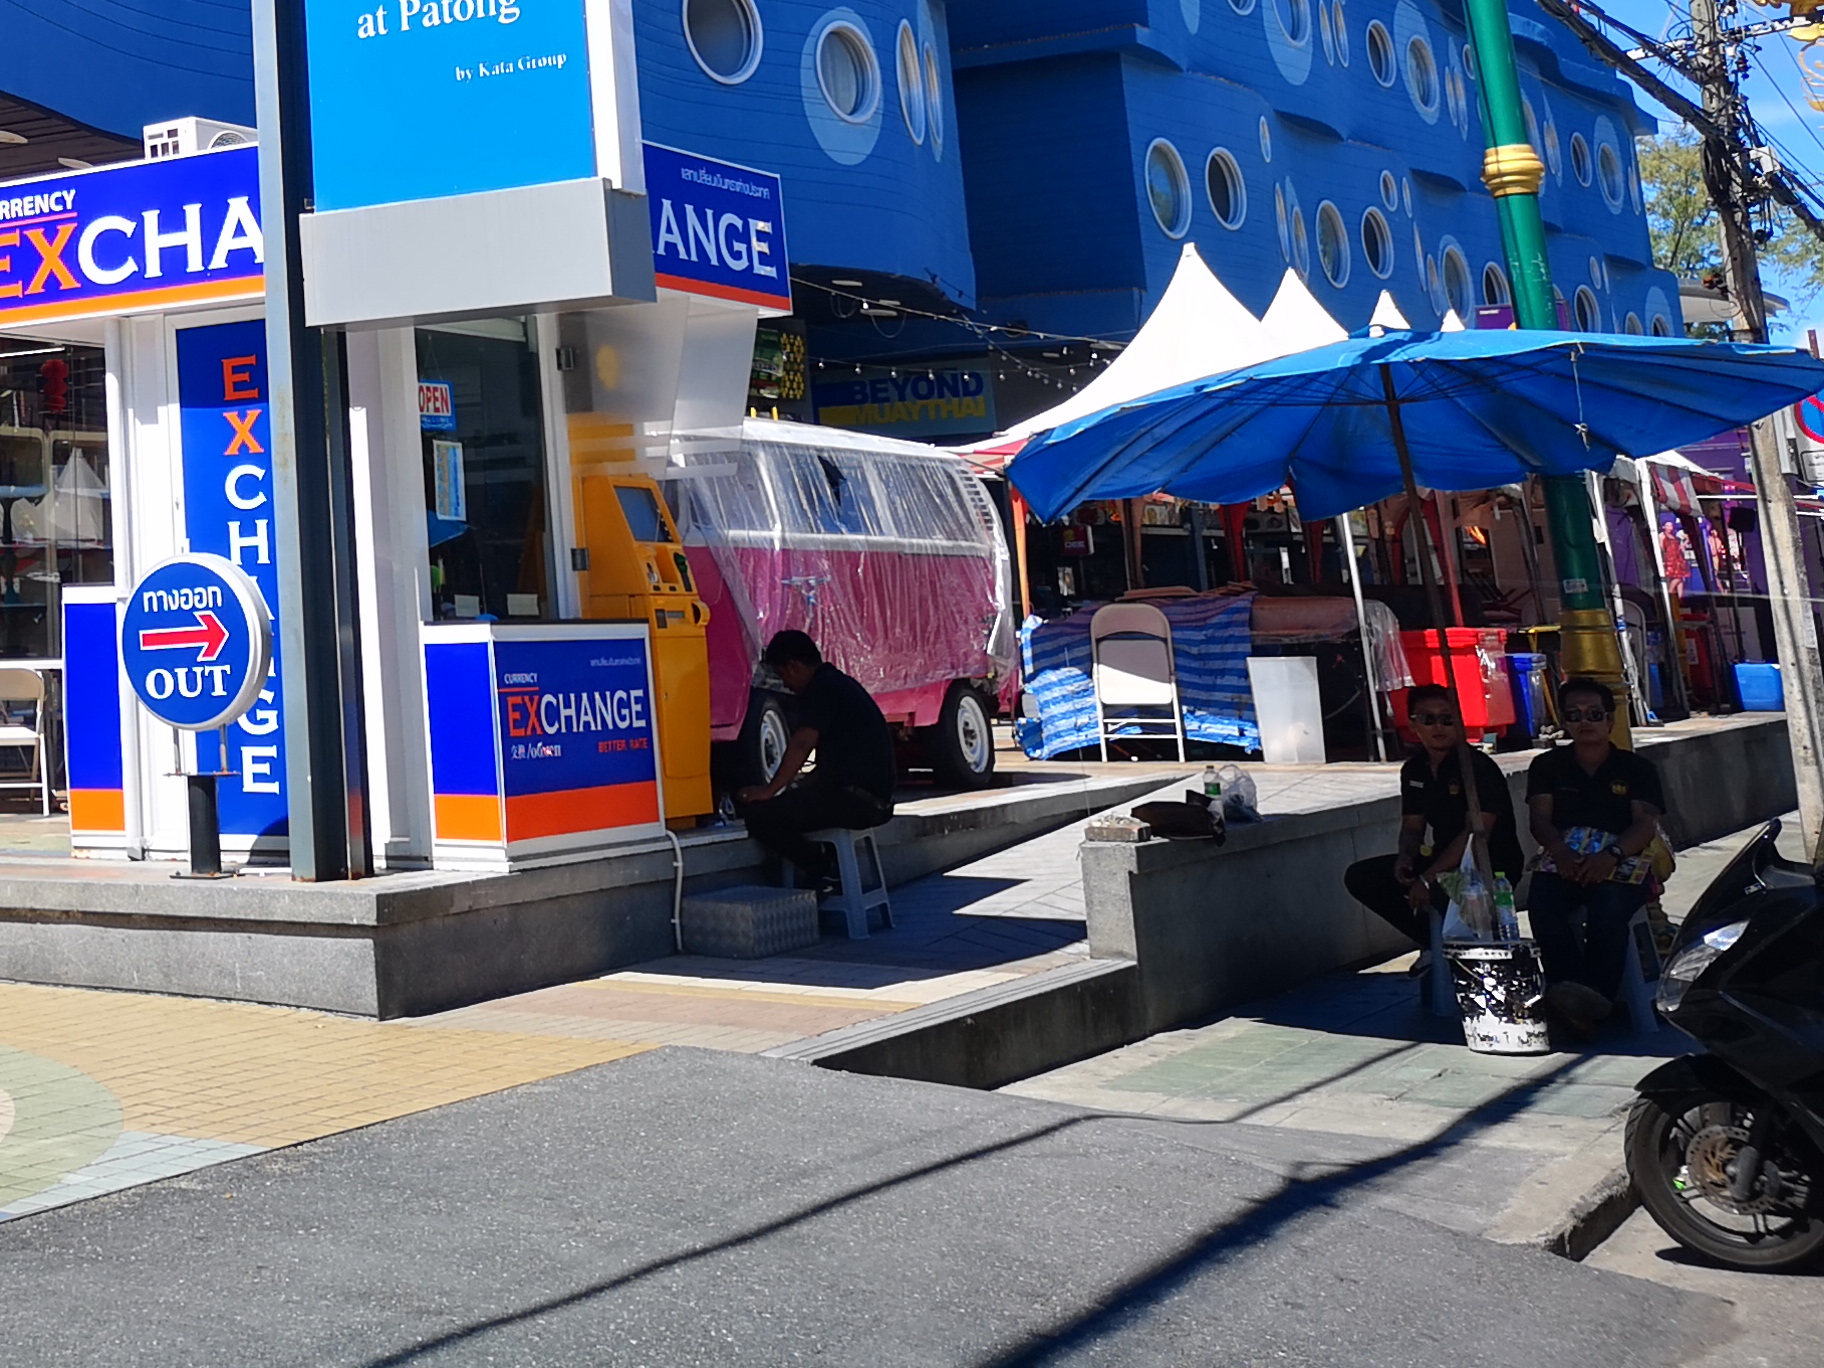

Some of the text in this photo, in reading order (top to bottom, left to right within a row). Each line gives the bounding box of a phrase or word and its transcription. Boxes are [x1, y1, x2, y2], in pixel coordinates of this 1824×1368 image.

[357, 4, 387, 38] at
[455, 53, 567, 83] by Kata Group
[653, 198, 778, 280] ANGE
[419, 385, 450, 413] OPEN
[853, 371, 984, 405] BEYOND
[853, 396, 986, 425] MUAYTHAI
[143, 586, 222, 612] ทางออก
[145, 665, 231, 699] OUT
[504, 673, 537, 684] CURRENCY
[507, 689, 647, 737] EXCHANGE
